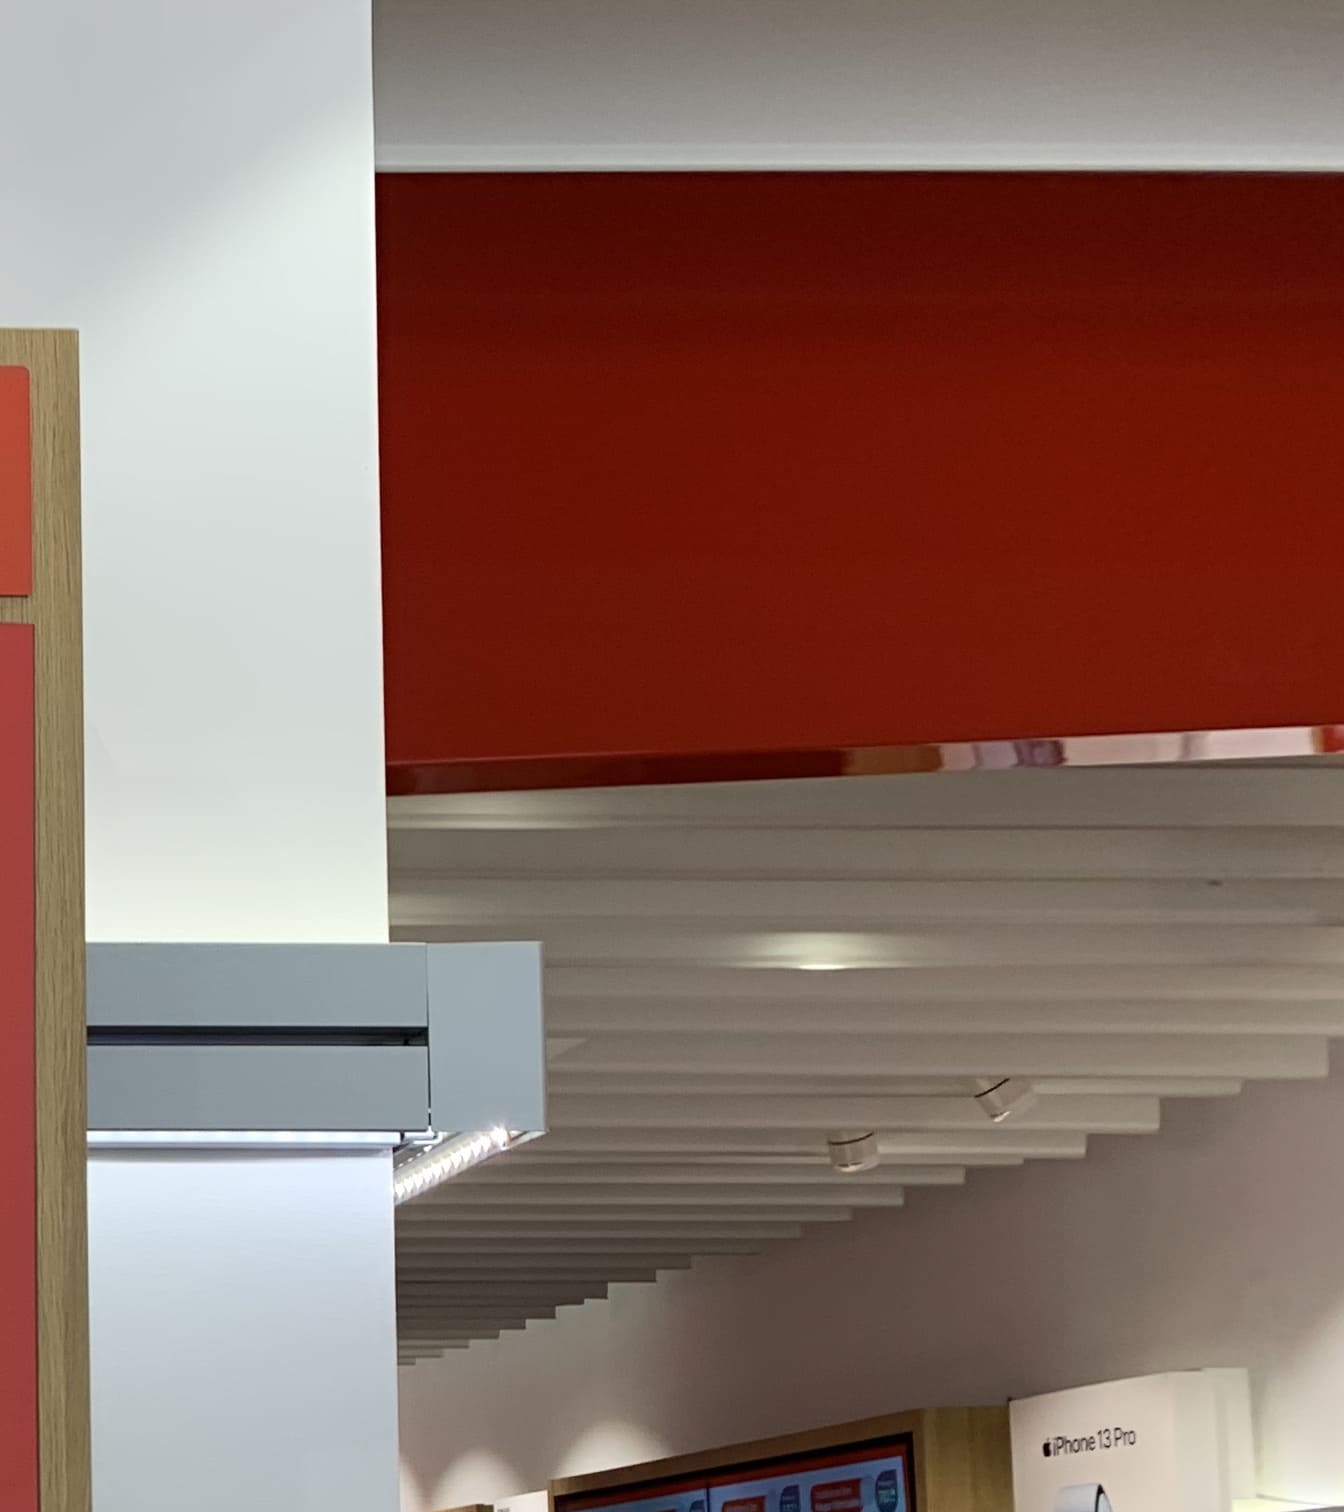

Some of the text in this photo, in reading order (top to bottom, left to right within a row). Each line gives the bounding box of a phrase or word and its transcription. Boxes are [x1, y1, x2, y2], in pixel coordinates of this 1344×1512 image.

[1052, 1426, 1137, 1457] iPhone 13 Pro
